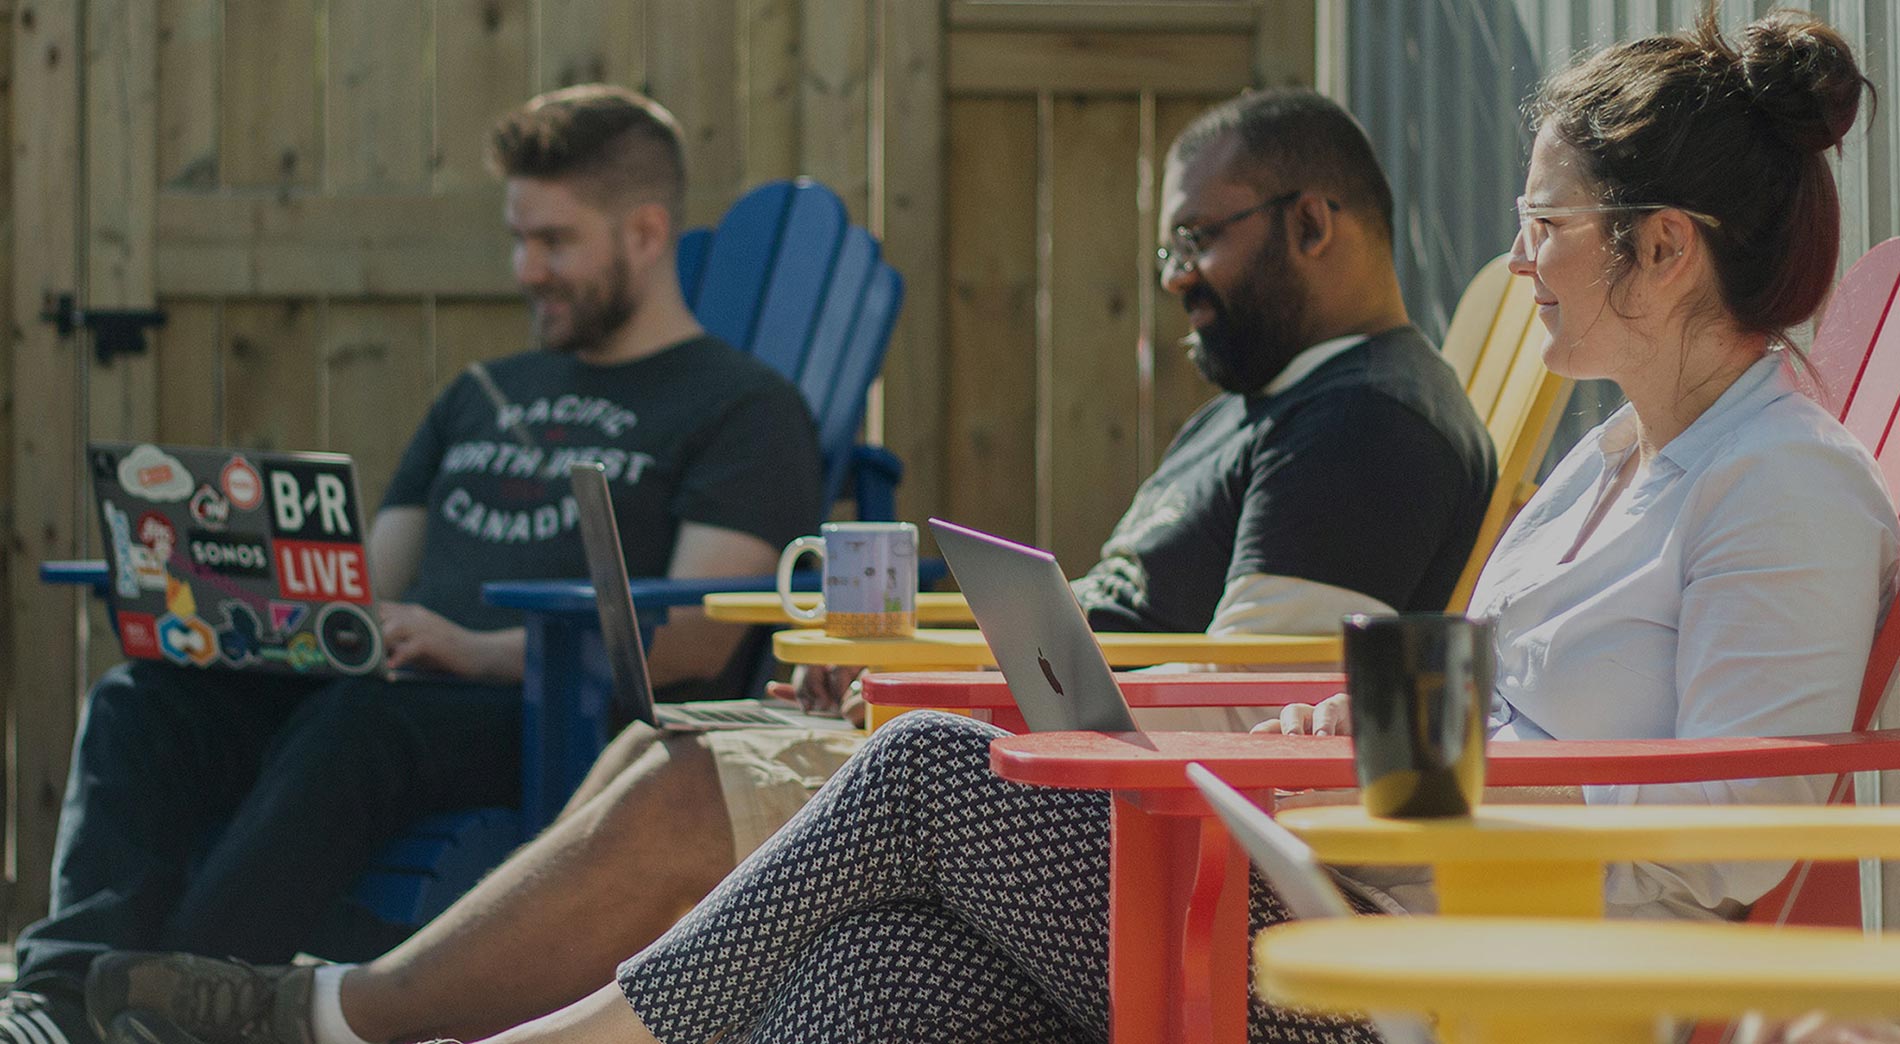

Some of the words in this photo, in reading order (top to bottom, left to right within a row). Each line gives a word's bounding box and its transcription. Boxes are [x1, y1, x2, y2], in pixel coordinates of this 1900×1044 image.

[497, 394, 638, 438] PACIFIC
[190, 541, 268, 569] SONOS
[281, 546, 364, 598] LIVE
